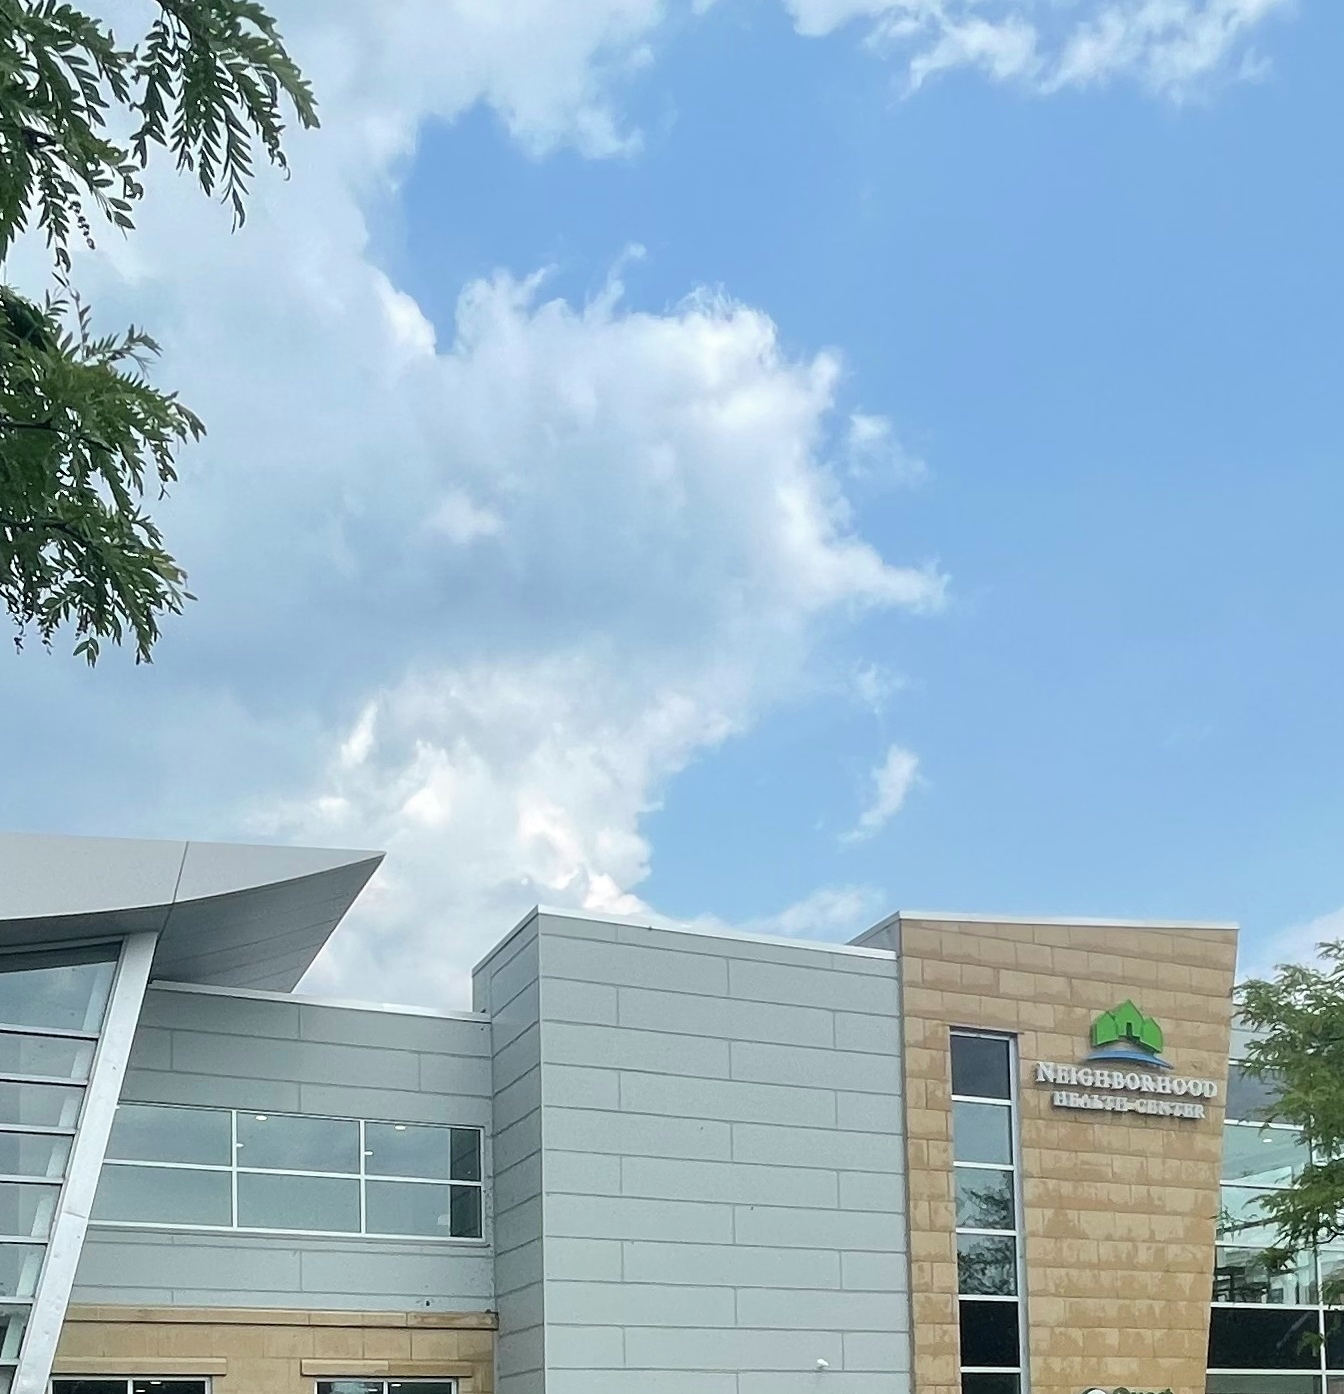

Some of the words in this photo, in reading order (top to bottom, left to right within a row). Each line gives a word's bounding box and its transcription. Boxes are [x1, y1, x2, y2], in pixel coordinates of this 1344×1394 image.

[1036, 1061, 1218, 1098] NEIGHBORHOOD
[1053, 1091, 1128, 1112] HEALTH
[1134, 1098, 1205, 1119] CENTER
